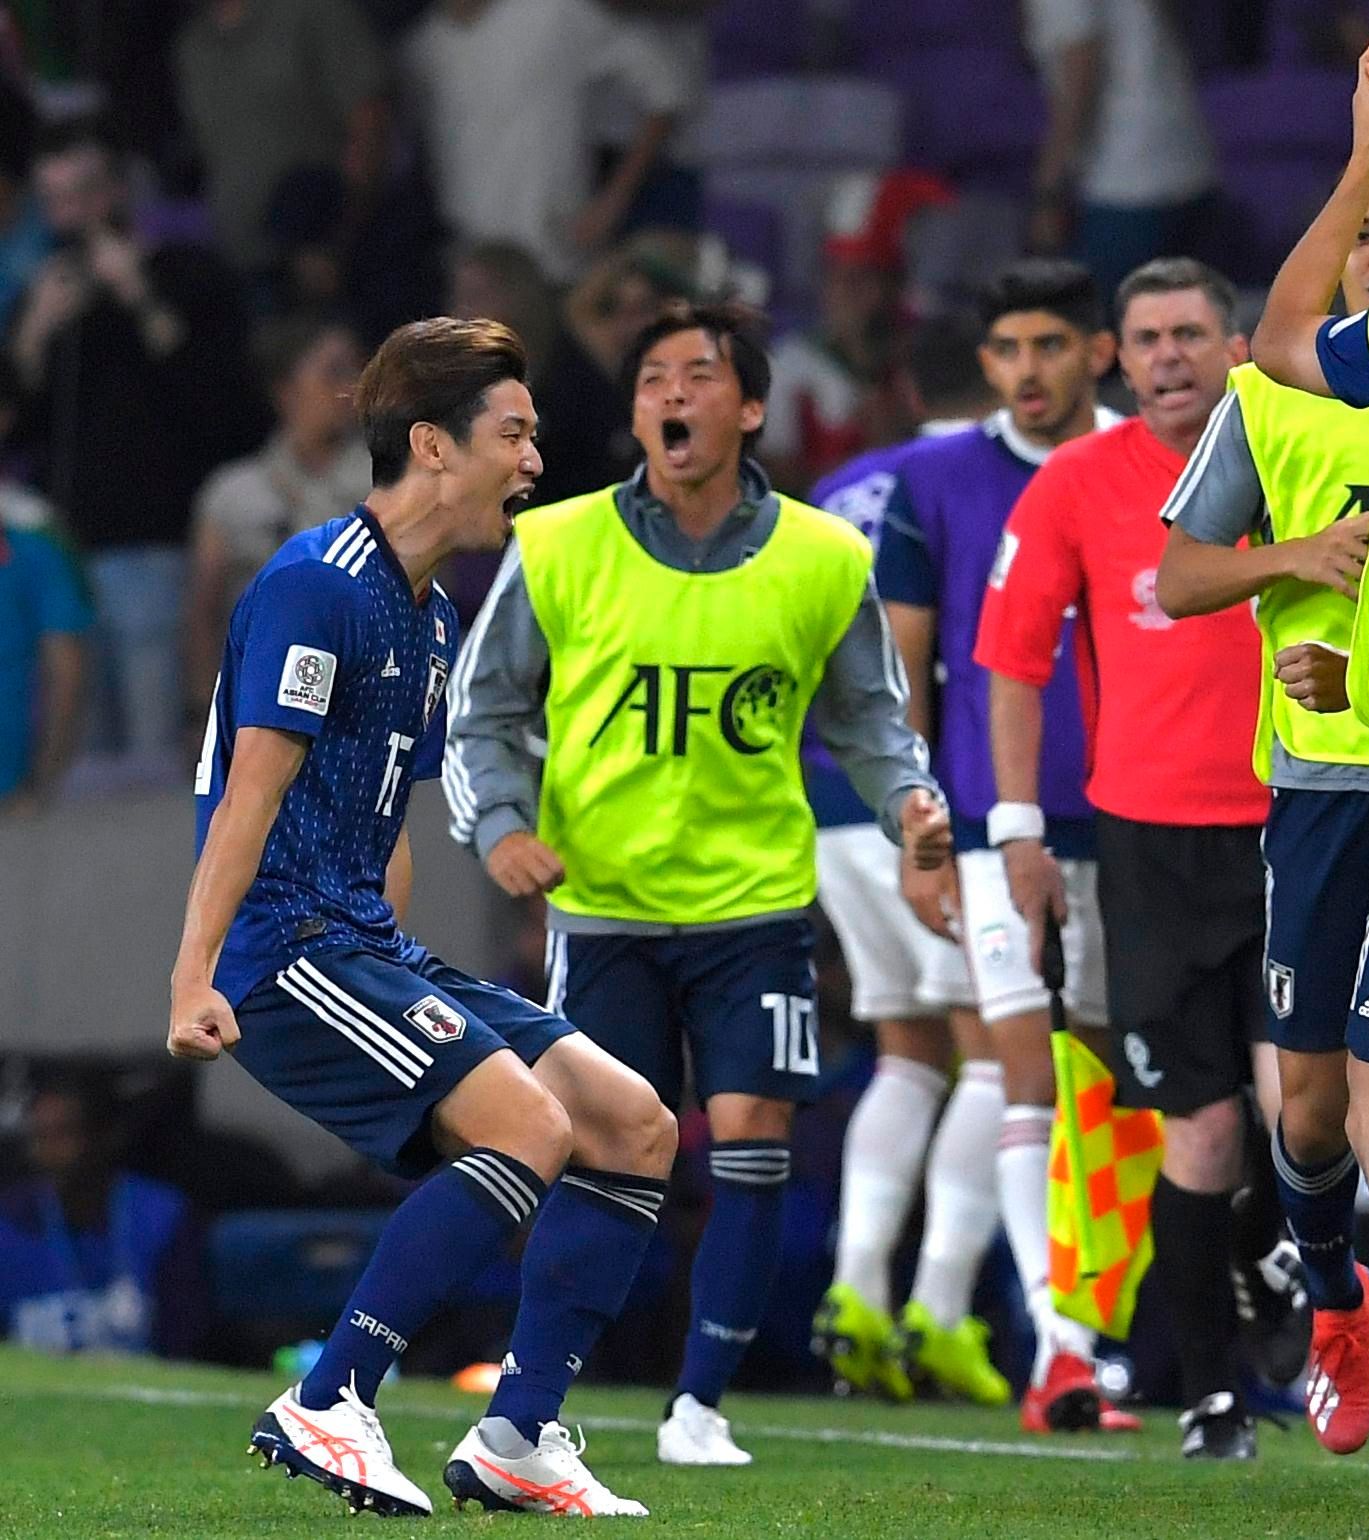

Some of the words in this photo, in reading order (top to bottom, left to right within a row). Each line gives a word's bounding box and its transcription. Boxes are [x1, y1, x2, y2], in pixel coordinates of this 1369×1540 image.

[588, 664, 788, 757] AFC
[761, 992, 819, 1076] 10
[350, 1309, 408, 1354] JAPAN
